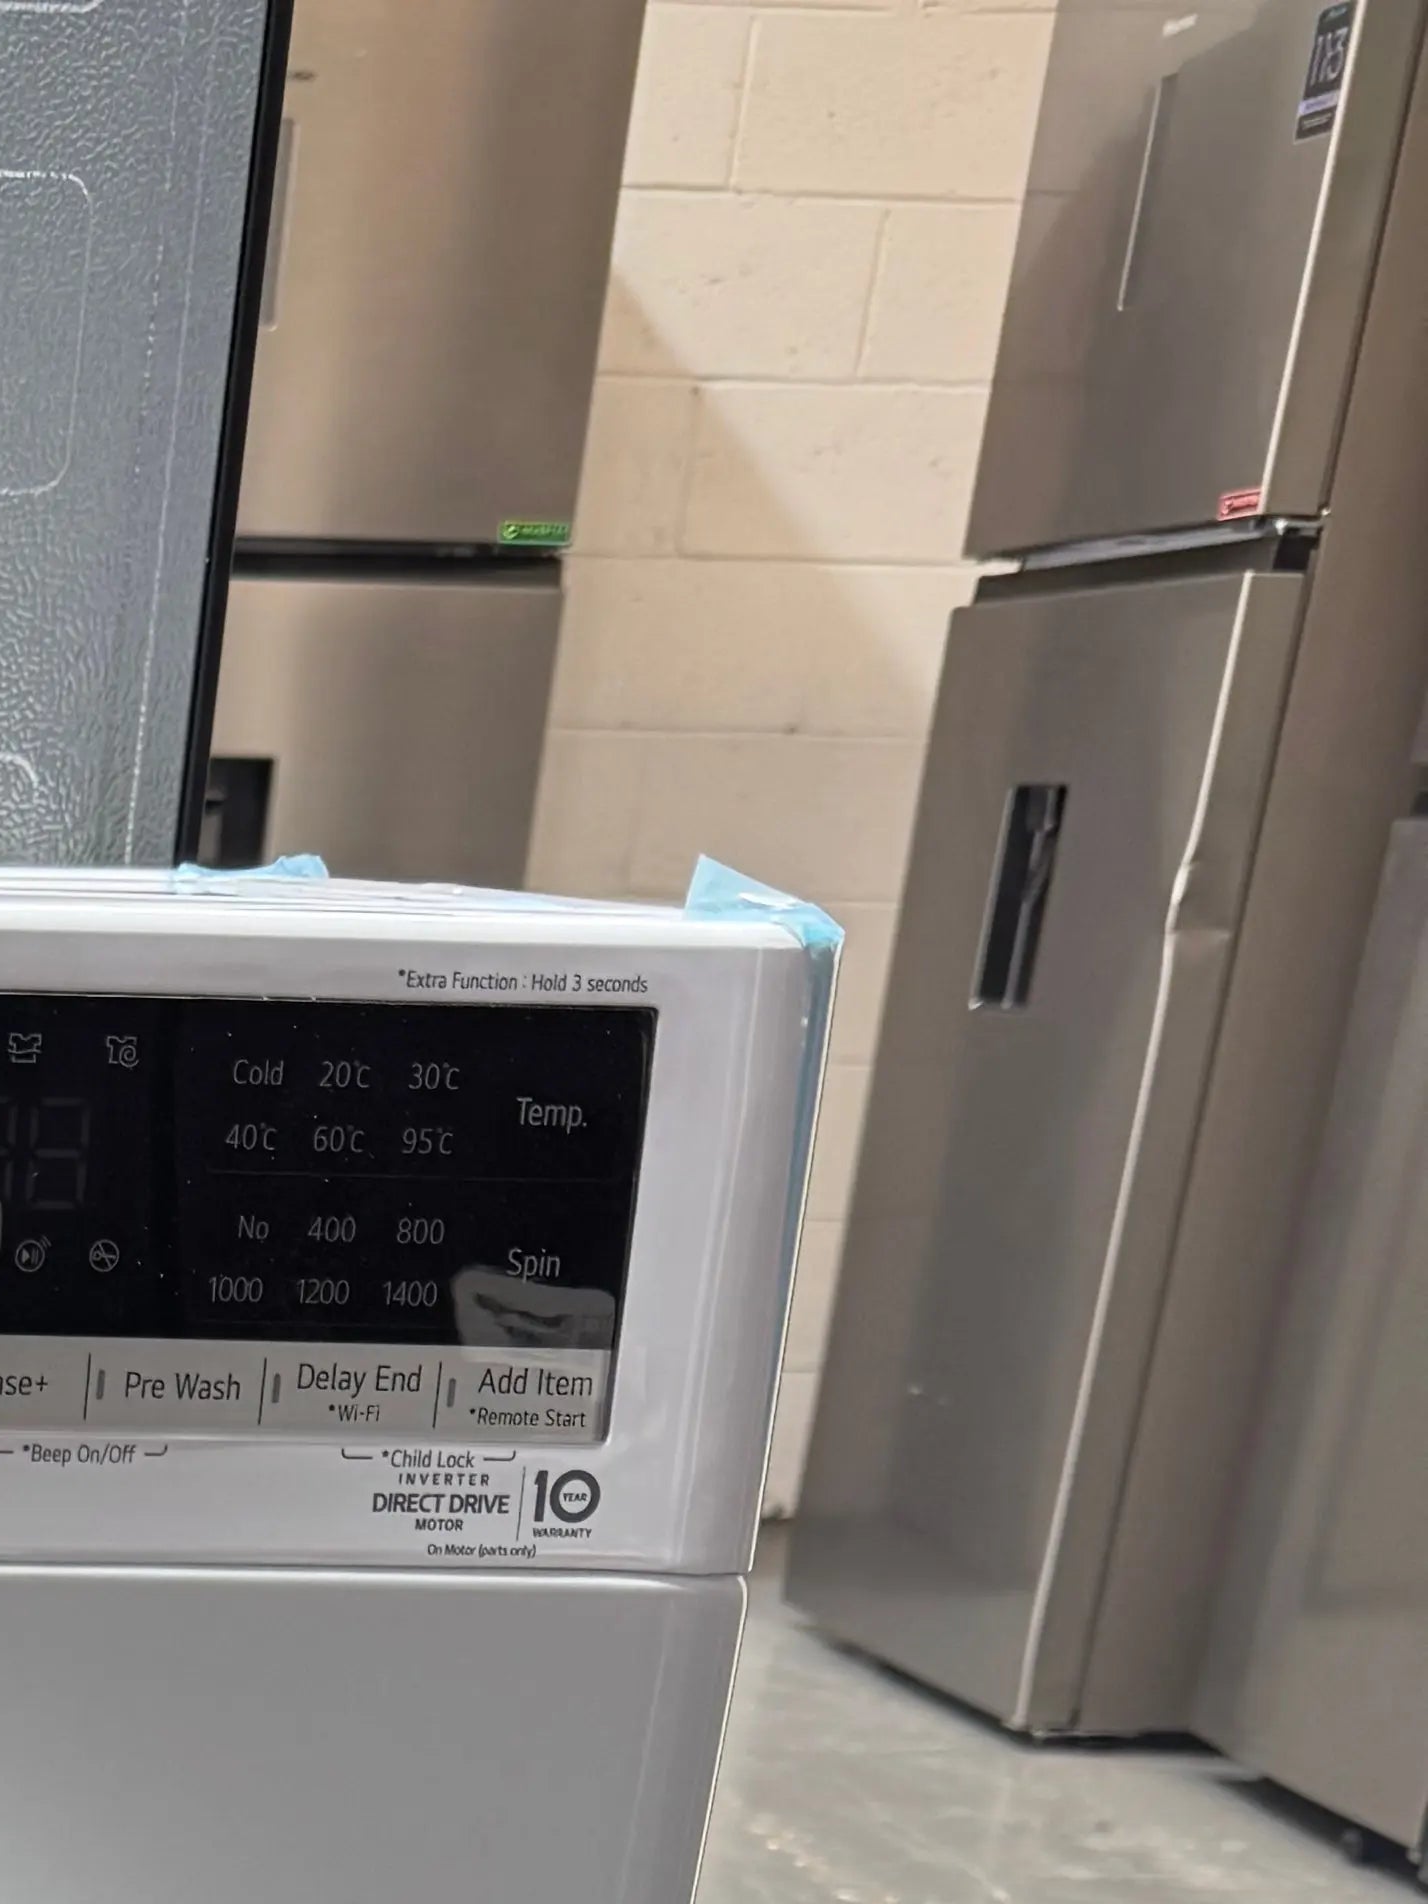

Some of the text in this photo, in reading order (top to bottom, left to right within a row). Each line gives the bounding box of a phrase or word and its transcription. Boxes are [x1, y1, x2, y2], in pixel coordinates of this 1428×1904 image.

[452, 971, 518, 991] Function
[531, 974, 567, 993] Hold
[572, 974, 583, 993] 3
[587, 975, 649, 994] seconds
[232, 1058, 285, 1086] Cold
[515, 1096, 588, 1135] Temp.
[238, 1215, 270, 1241] No
[307, 1216, 357, 1242] 400
[396, 1218, 444, 1244] 800
[506, 1247, 561, 1284] Spin
[208, 1276, 264, 1304] 1000
[295, 1278, 350, 1306] 1200
[382, 1280, 439, 1308] 1400
[124, 1371, 242, 1402] Pre Wash
[296, 1362, 423, 1395] Delay End
[477, 1367, 594, 1397] Add Item
[544, 1409, 587, 1428] Start
[77, 1444, 137, 1466] On/Off
[437, 1450, 476, 1469] Lock
[398, 1472, 491, 1487] INVERTER
[372, 1491, 511, 1515] DIRECT DRIVE
[562, 1491, 588, 1503] YEAR
[414, 1518, 464, 1532] MOTOR
[427, 1543, 442, 1557] On
[445, 1543, 477, 1557] Motor
[509, 1544, 538, 1560] only)
